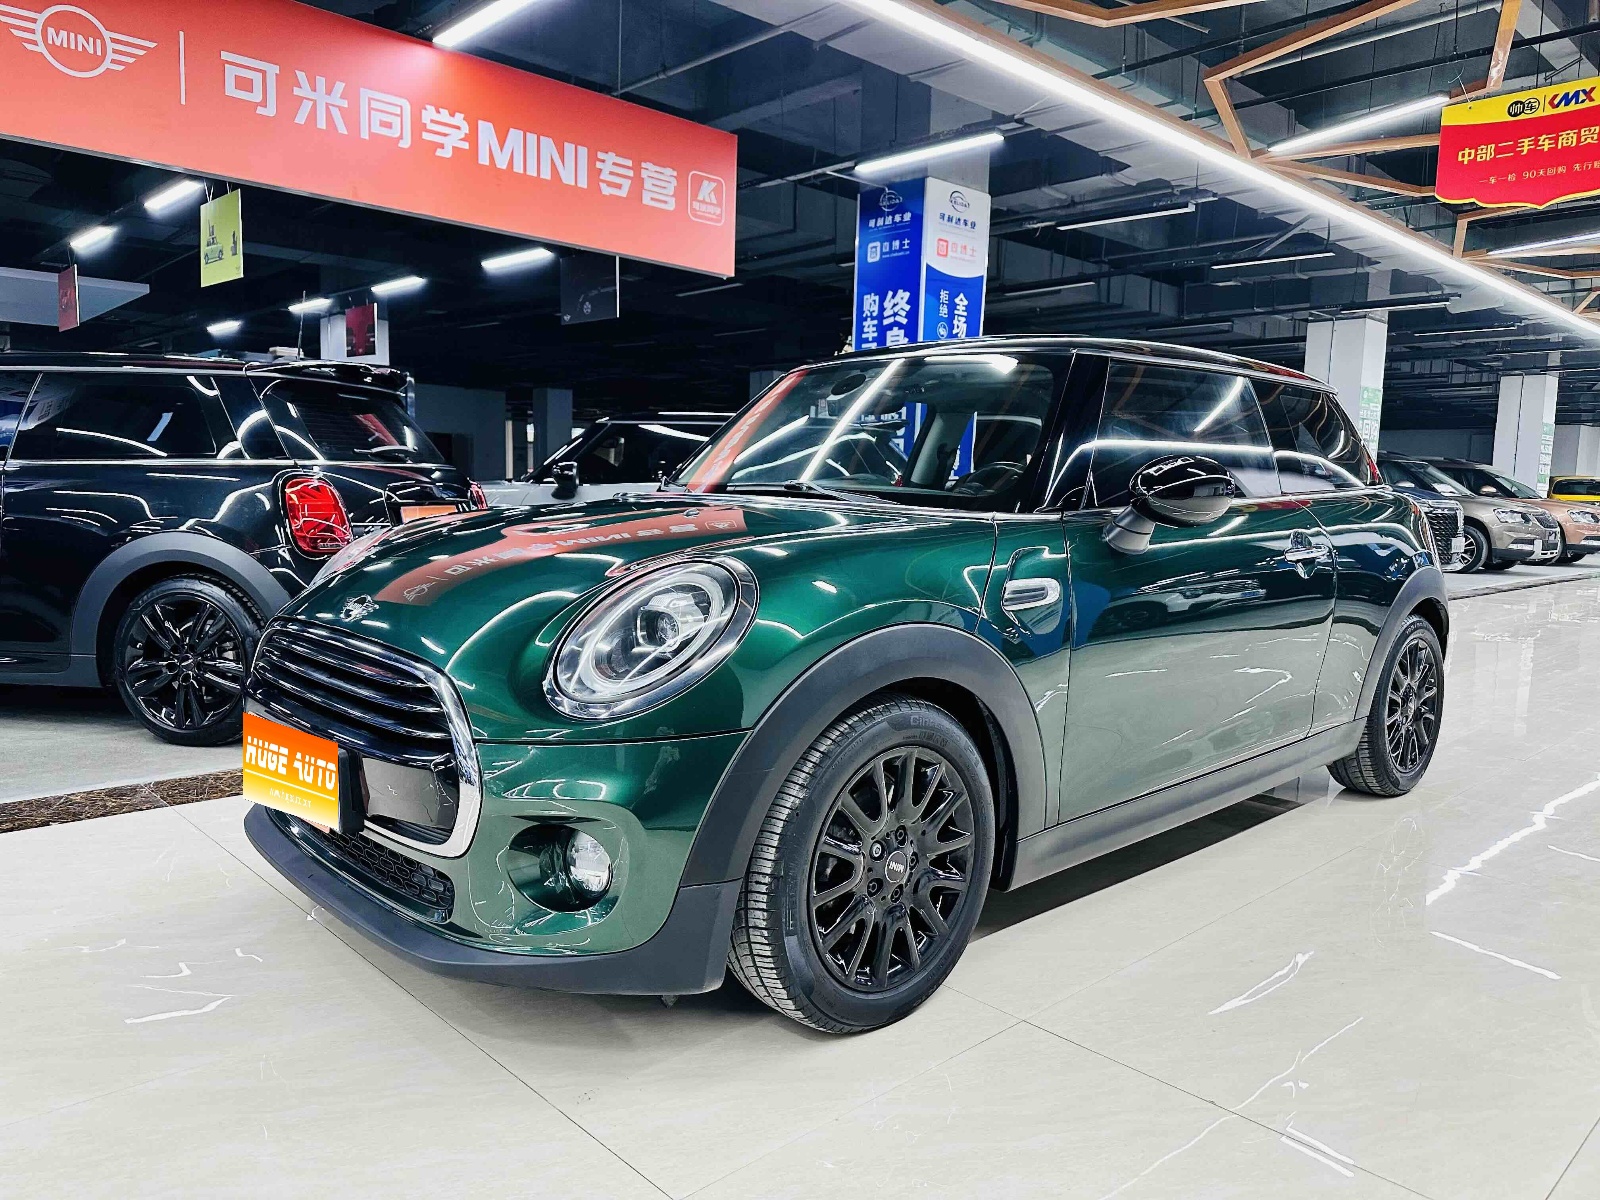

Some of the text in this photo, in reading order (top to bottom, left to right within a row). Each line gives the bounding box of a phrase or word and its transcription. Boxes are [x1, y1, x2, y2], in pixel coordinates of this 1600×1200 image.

[47, 27, 101, 56] MINI
[1509, 99, 1538, 116] 帅车
[220, 51, 677, 211] 可米同学MINI专营
[1457, 125, 1600, 165] 中部二手车商贸
[1522, 165, 1567, 180] 90天回购
[938, 289, 949, 318] 拒绝
[952, 292, 969, 339] 全场
[861, 292, 880, 350] 购车
